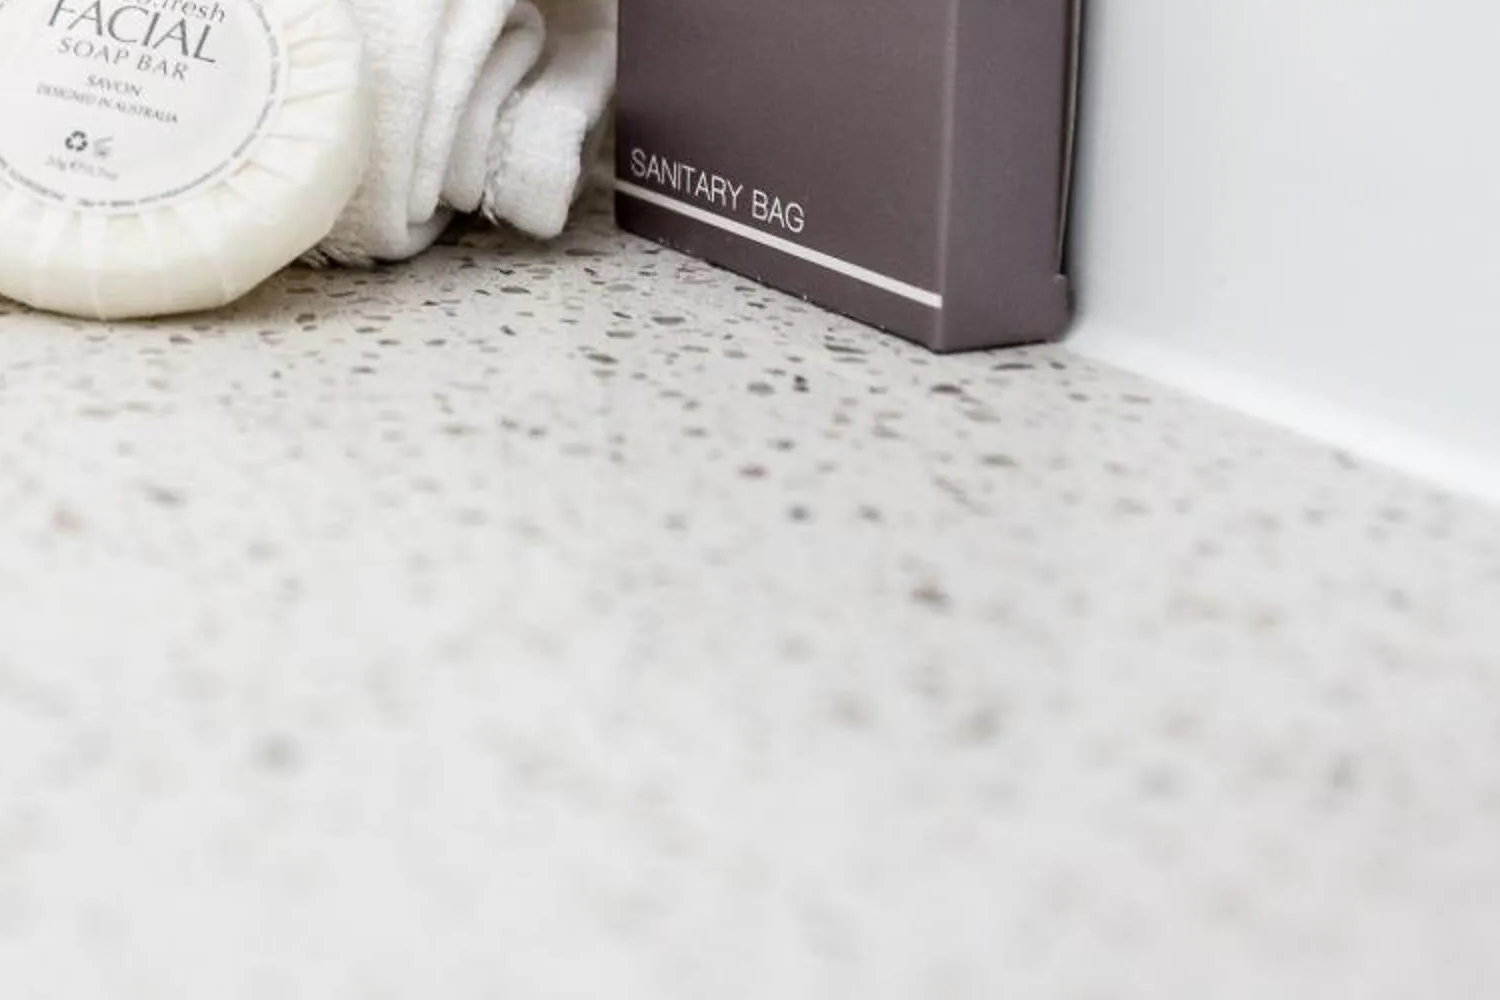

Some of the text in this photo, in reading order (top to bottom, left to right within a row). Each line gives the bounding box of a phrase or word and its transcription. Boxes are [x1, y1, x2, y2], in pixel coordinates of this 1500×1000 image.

[57, 36, 190, 81] SOAP BAR
[86, 74, 143, 97] SAVON
[629, 147, 806, 234] SANITARY BAG
